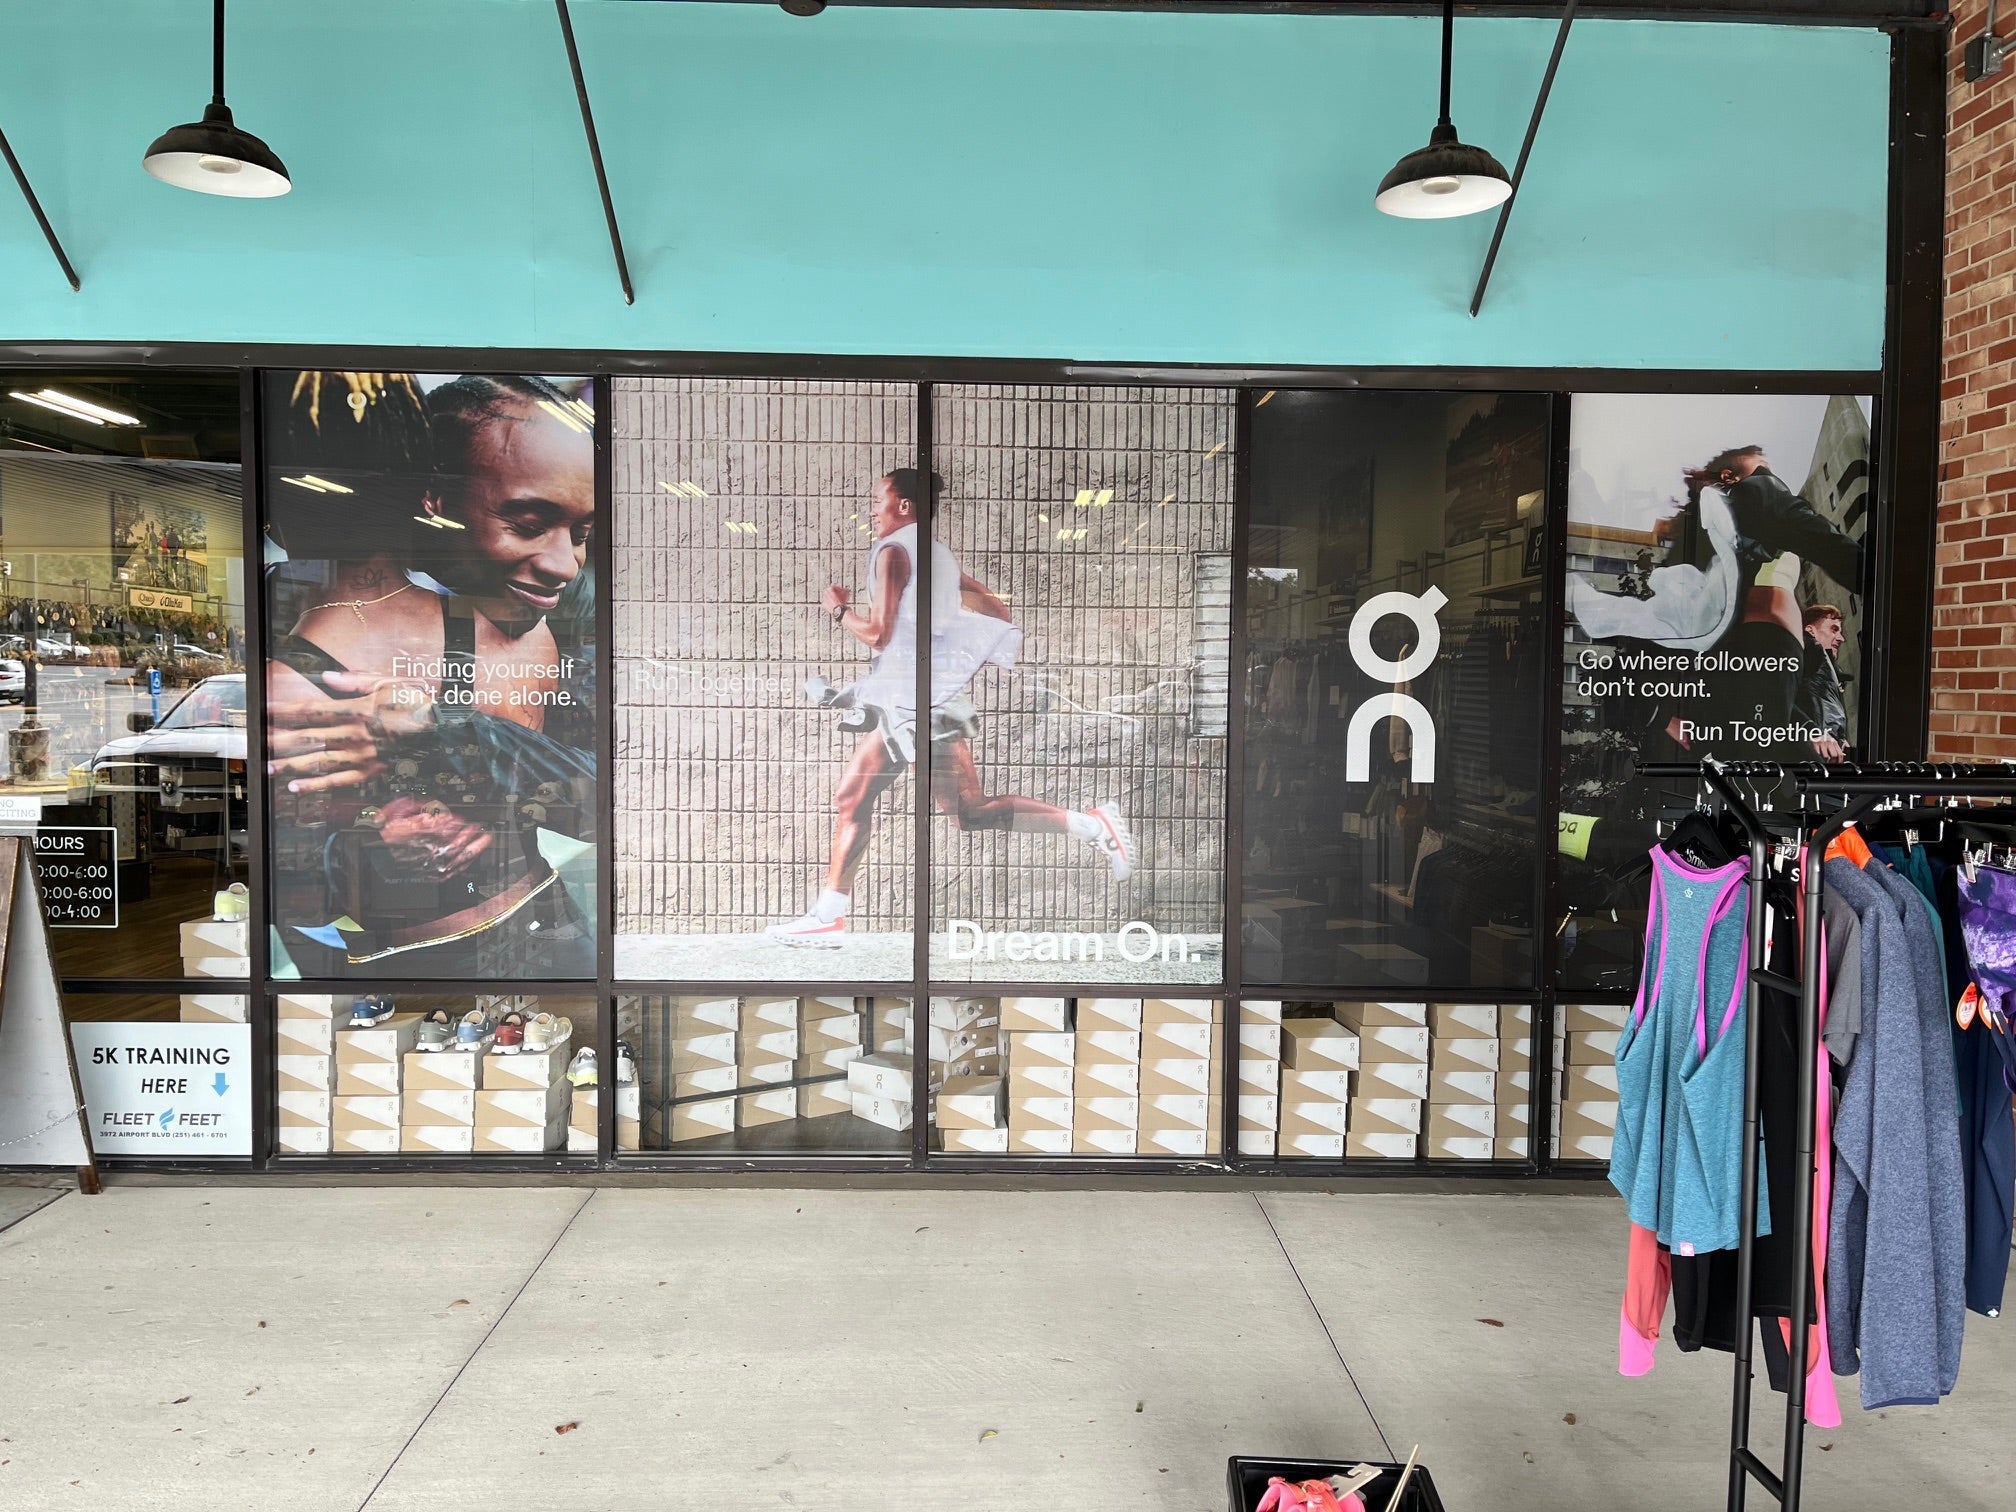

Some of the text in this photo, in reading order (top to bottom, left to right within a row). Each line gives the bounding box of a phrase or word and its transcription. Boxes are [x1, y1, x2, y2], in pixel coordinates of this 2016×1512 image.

[391, 656, 575, 683] Finding yourself
[1578, 649, 1800, 672] Go where followers
[634, 669, 678, 692] Run
[1640, 677, 1712, 699] count.
[444, 684, 503, 706] done
[509, 685, 577, 706] alone.
[1679, 720, 1832, 748] Run Together
[33, 836, 85, 850] HOURS
[948, 919, 1202, 963] Dream On.
[92, 1047, 231, 1065] 5K TRAINING
[141, 1078, 188, 1094] HERE
[102, 1112, 222, 1126] FLEET FEET
[172, 1131, 191, 1139] (251)
